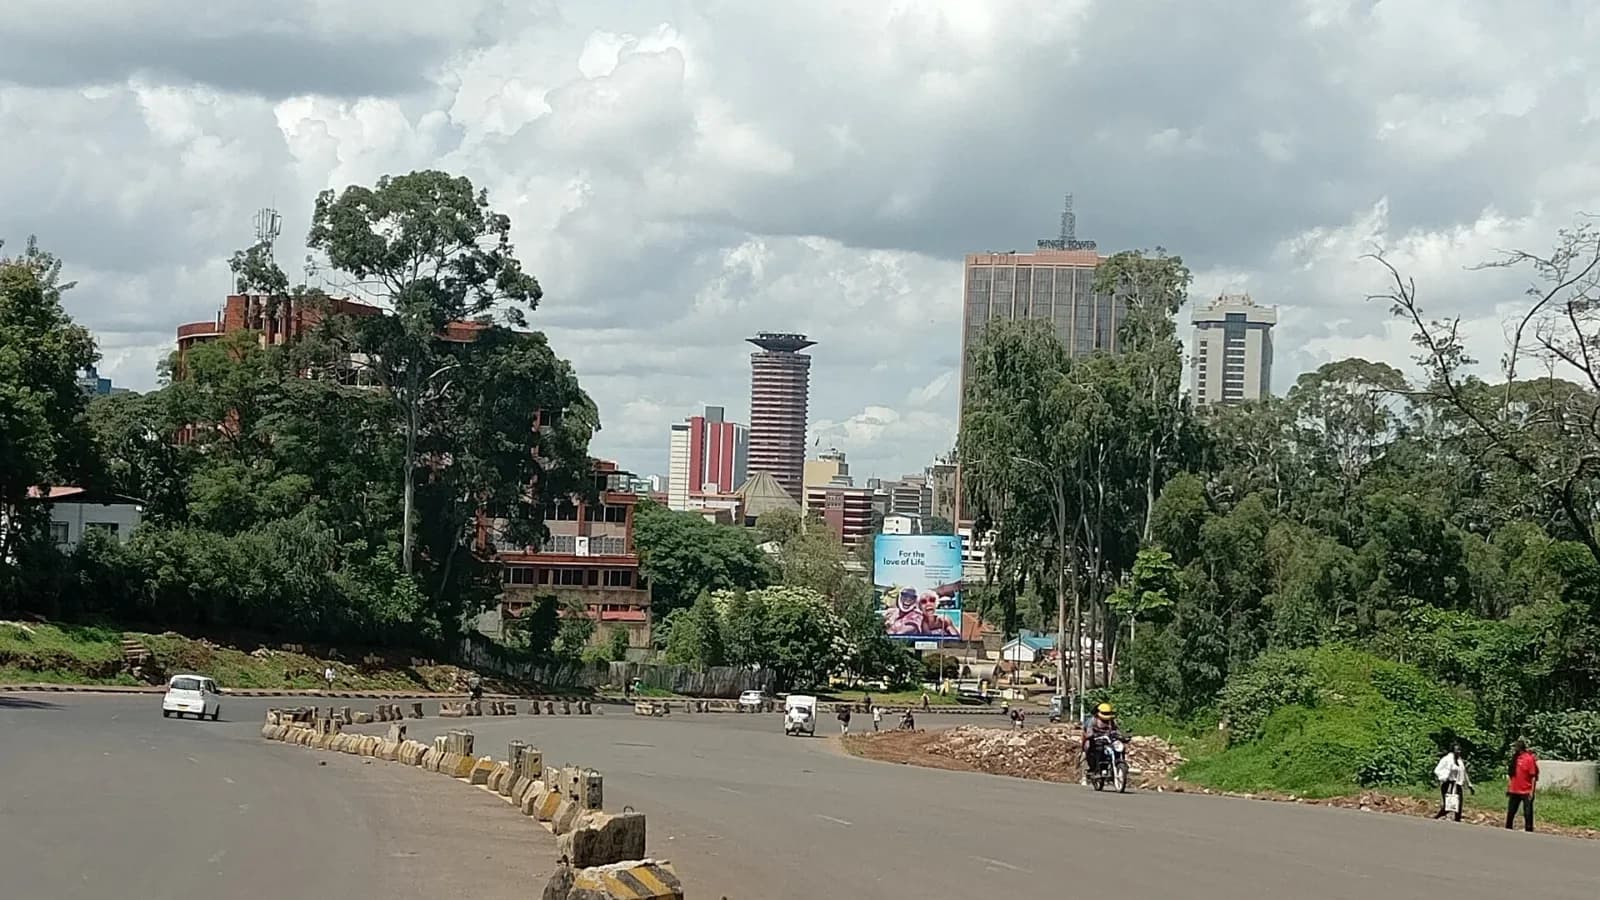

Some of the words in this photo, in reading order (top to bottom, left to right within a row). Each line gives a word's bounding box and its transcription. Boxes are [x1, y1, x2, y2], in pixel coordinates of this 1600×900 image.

[899, 550, 911, 558] For
[913, 550, 925, 558] the
[883, 557, 900, 566] love
[901, 557, 909, 566] of
[911, 557, 925, 566] Life
